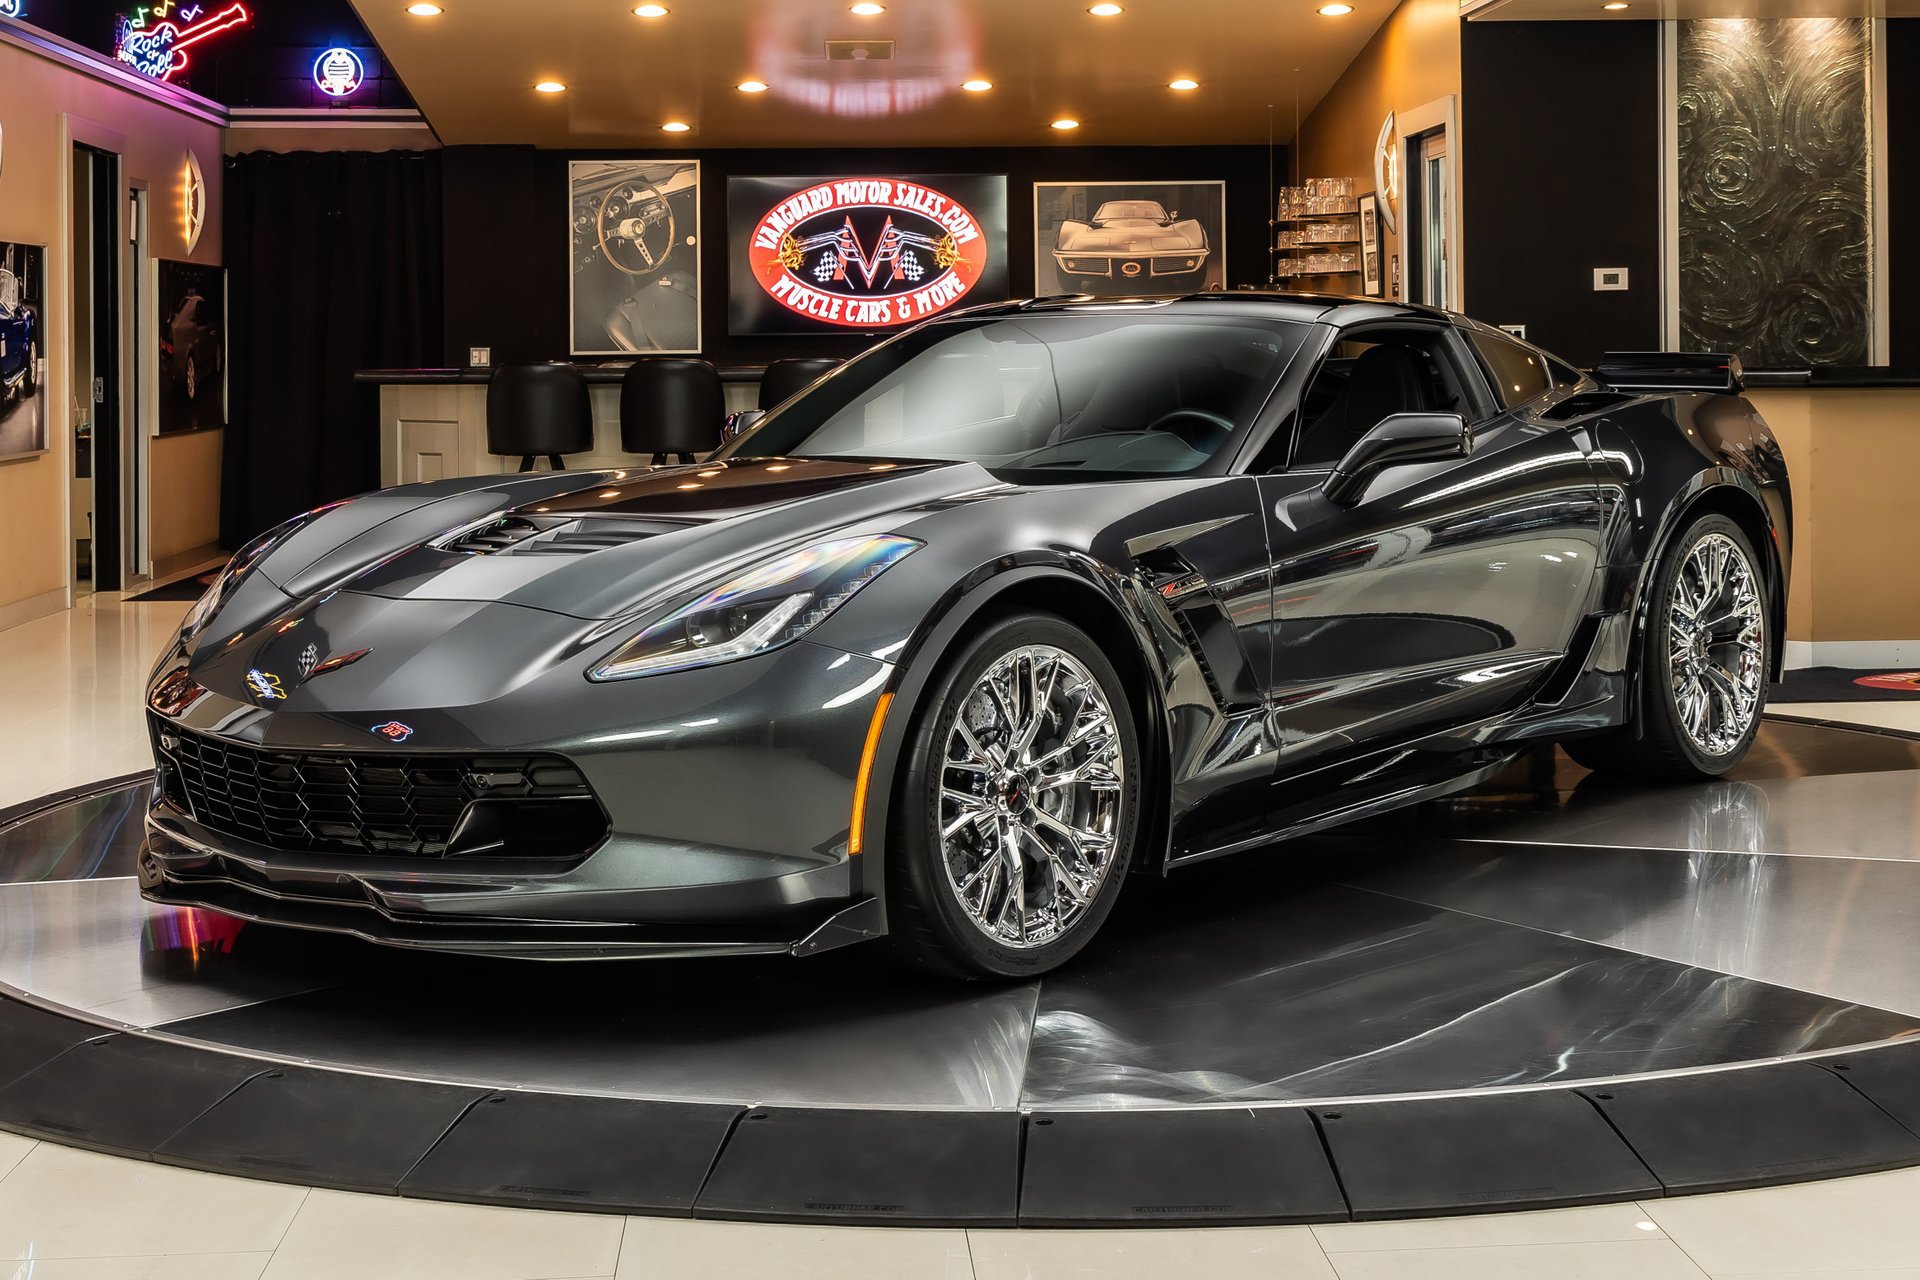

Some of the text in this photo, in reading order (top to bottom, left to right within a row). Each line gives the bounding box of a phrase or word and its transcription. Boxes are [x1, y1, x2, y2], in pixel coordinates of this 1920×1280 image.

[131, 25, 173, 55] Rock
[755, 181, 979, 250] VANGUARD MOTOR SALES.COM
[770, 271, 966, 323] MUSCLE CARS & MORE
